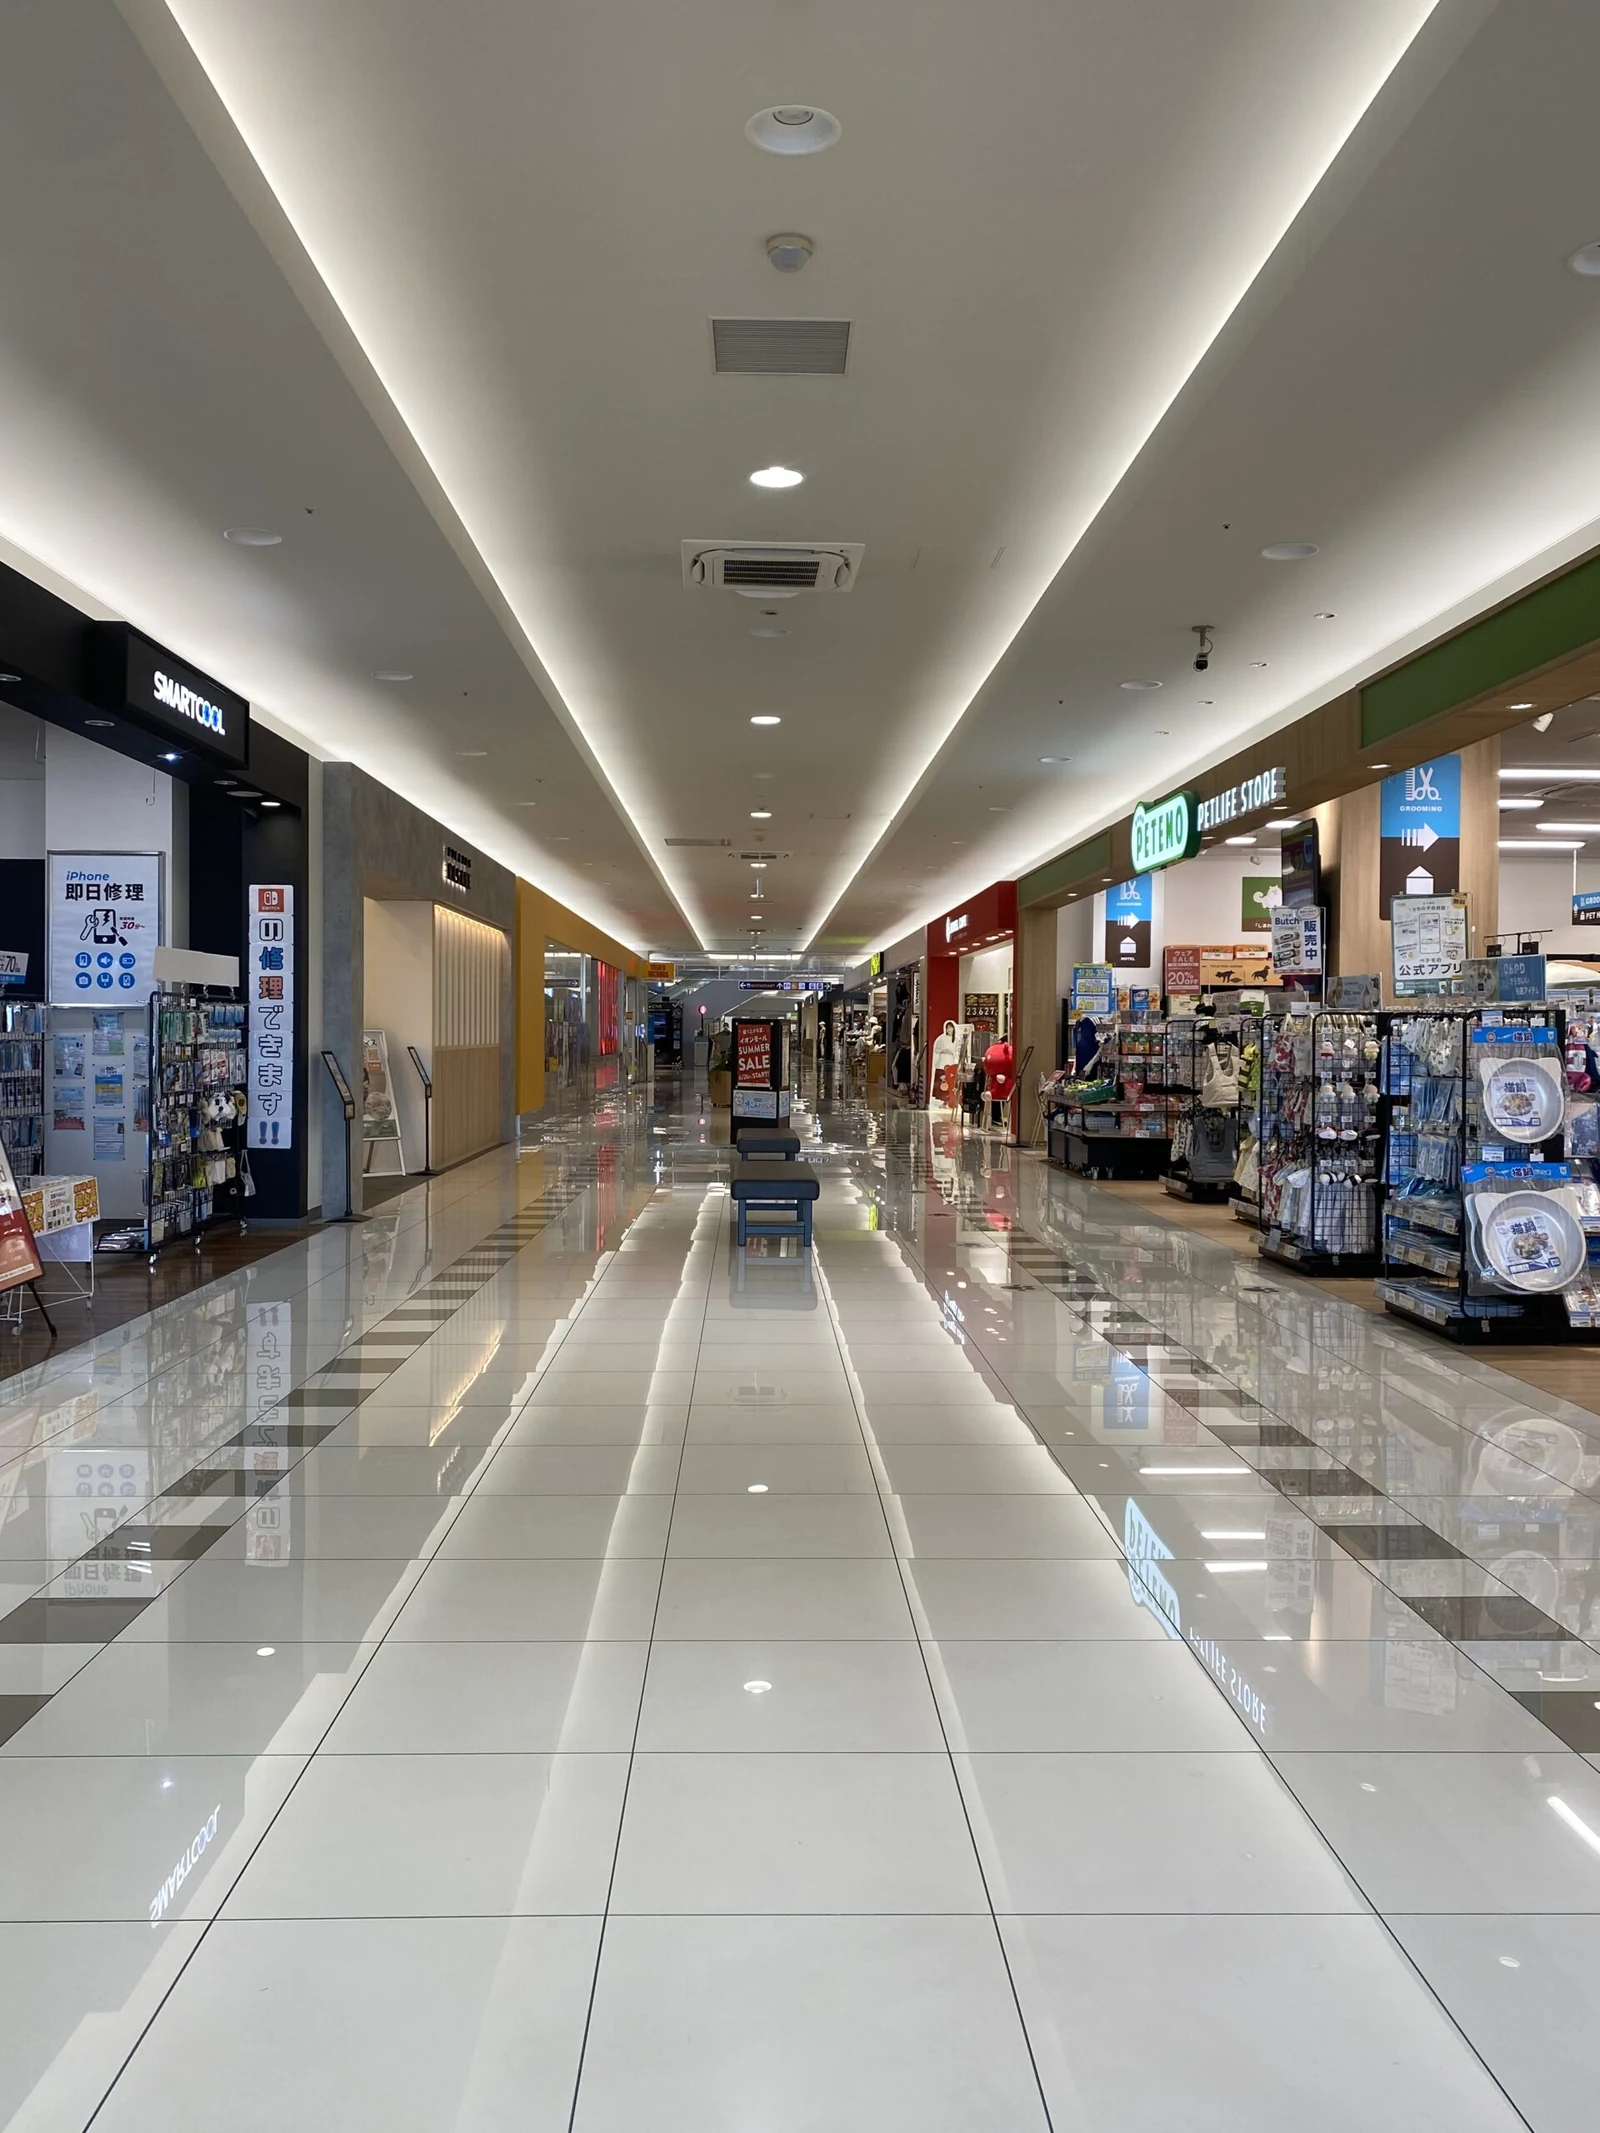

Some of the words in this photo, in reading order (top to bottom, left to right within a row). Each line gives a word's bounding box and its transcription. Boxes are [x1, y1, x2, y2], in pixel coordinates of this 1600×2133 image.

[153, 670, 226, 736] SMARTCOOL
[1198, 786, 1236, 831] PETLIFE
[1240, 766, 1283, 812] STORE
[1136, 805, 1183, 861] PETEMO
[66, 871, 110, 881] iPhone
[65, 883, 144, 901] 即日修理
[1275, 917, 1300, 926] Butch
[1586, 912, 1596, 920] PET
[1304, 920, 1318, 961] 販売中
[1399, 963, 1463, 977] 公式アプリ
[740, 1036, 767, 1044] イオンモール
[739, 1043, 770, 1055] SUMMER
[738, 1055, 770, 1071] SALE
